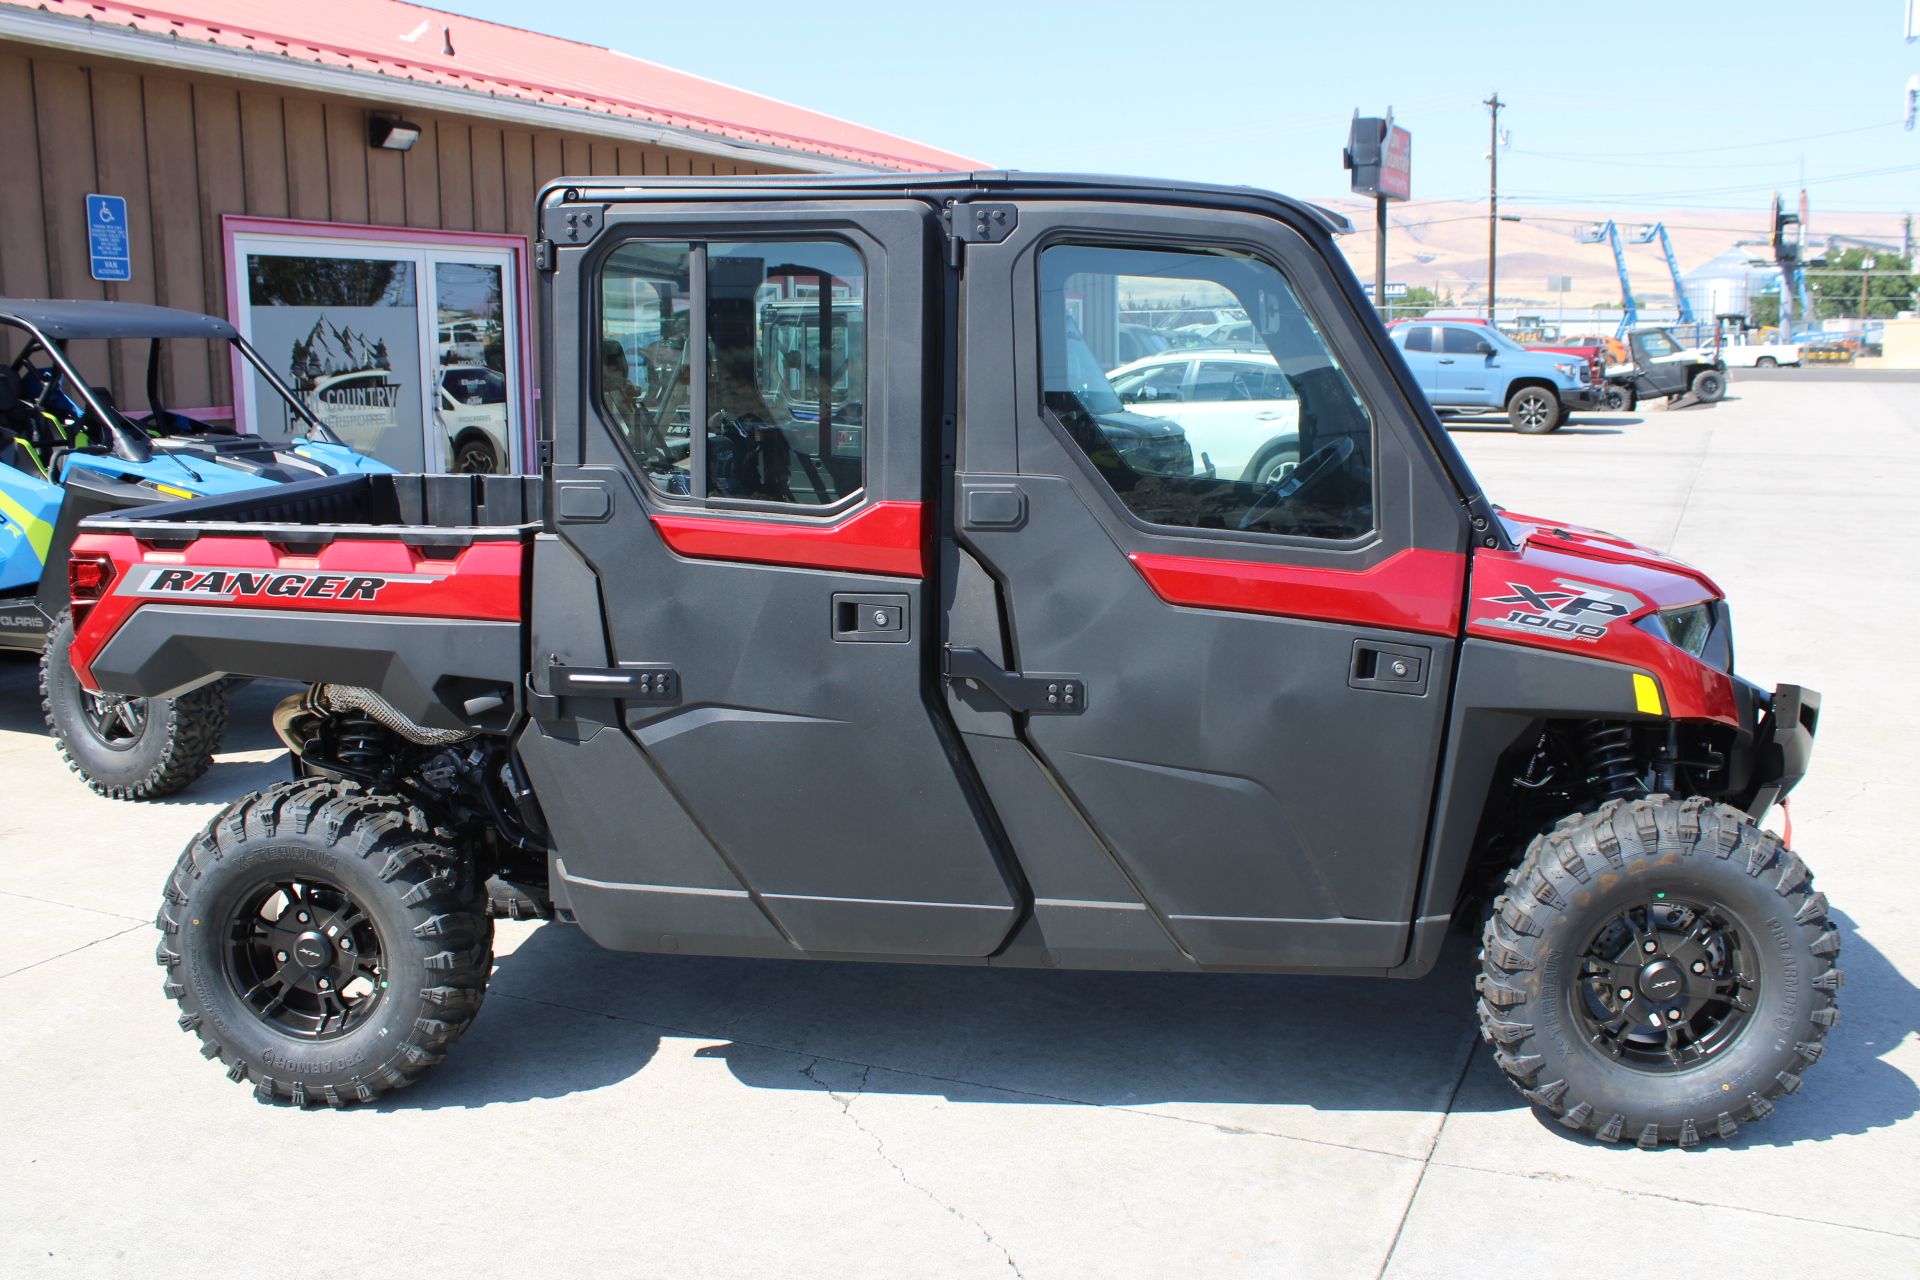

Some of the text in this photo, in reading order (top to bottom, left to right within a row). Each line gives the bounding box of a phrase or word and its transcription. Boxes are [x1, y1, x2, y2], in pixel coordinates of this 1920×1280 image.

[326, 384, 402, 426] COUNTRY
[149, 569, 388, 600] RANGER
[1480, 581, 1631, 618] XP
[1506, 609, 1609, 639] 1000
